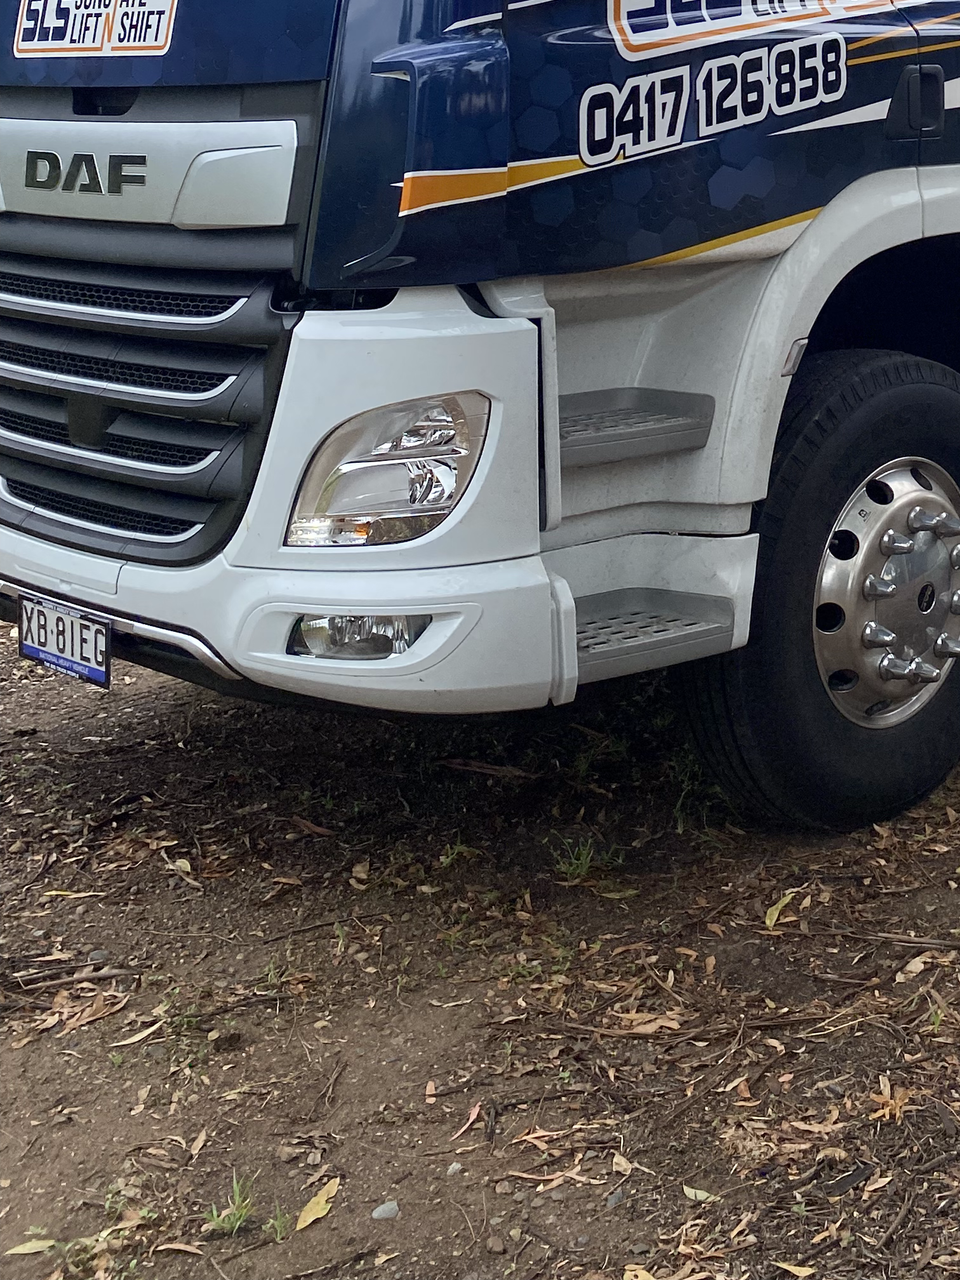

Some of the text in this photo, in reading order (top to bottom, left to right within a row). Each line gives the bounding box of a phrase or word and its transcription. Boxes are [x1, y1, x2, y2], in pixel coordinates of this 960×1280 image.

[69, 12, 103, 44] LIFT
[117, 10, 166, 44] SHIFT
[585, 38, 842, 158] 0417 126 858
[25, 149, 148, 196] DAF
